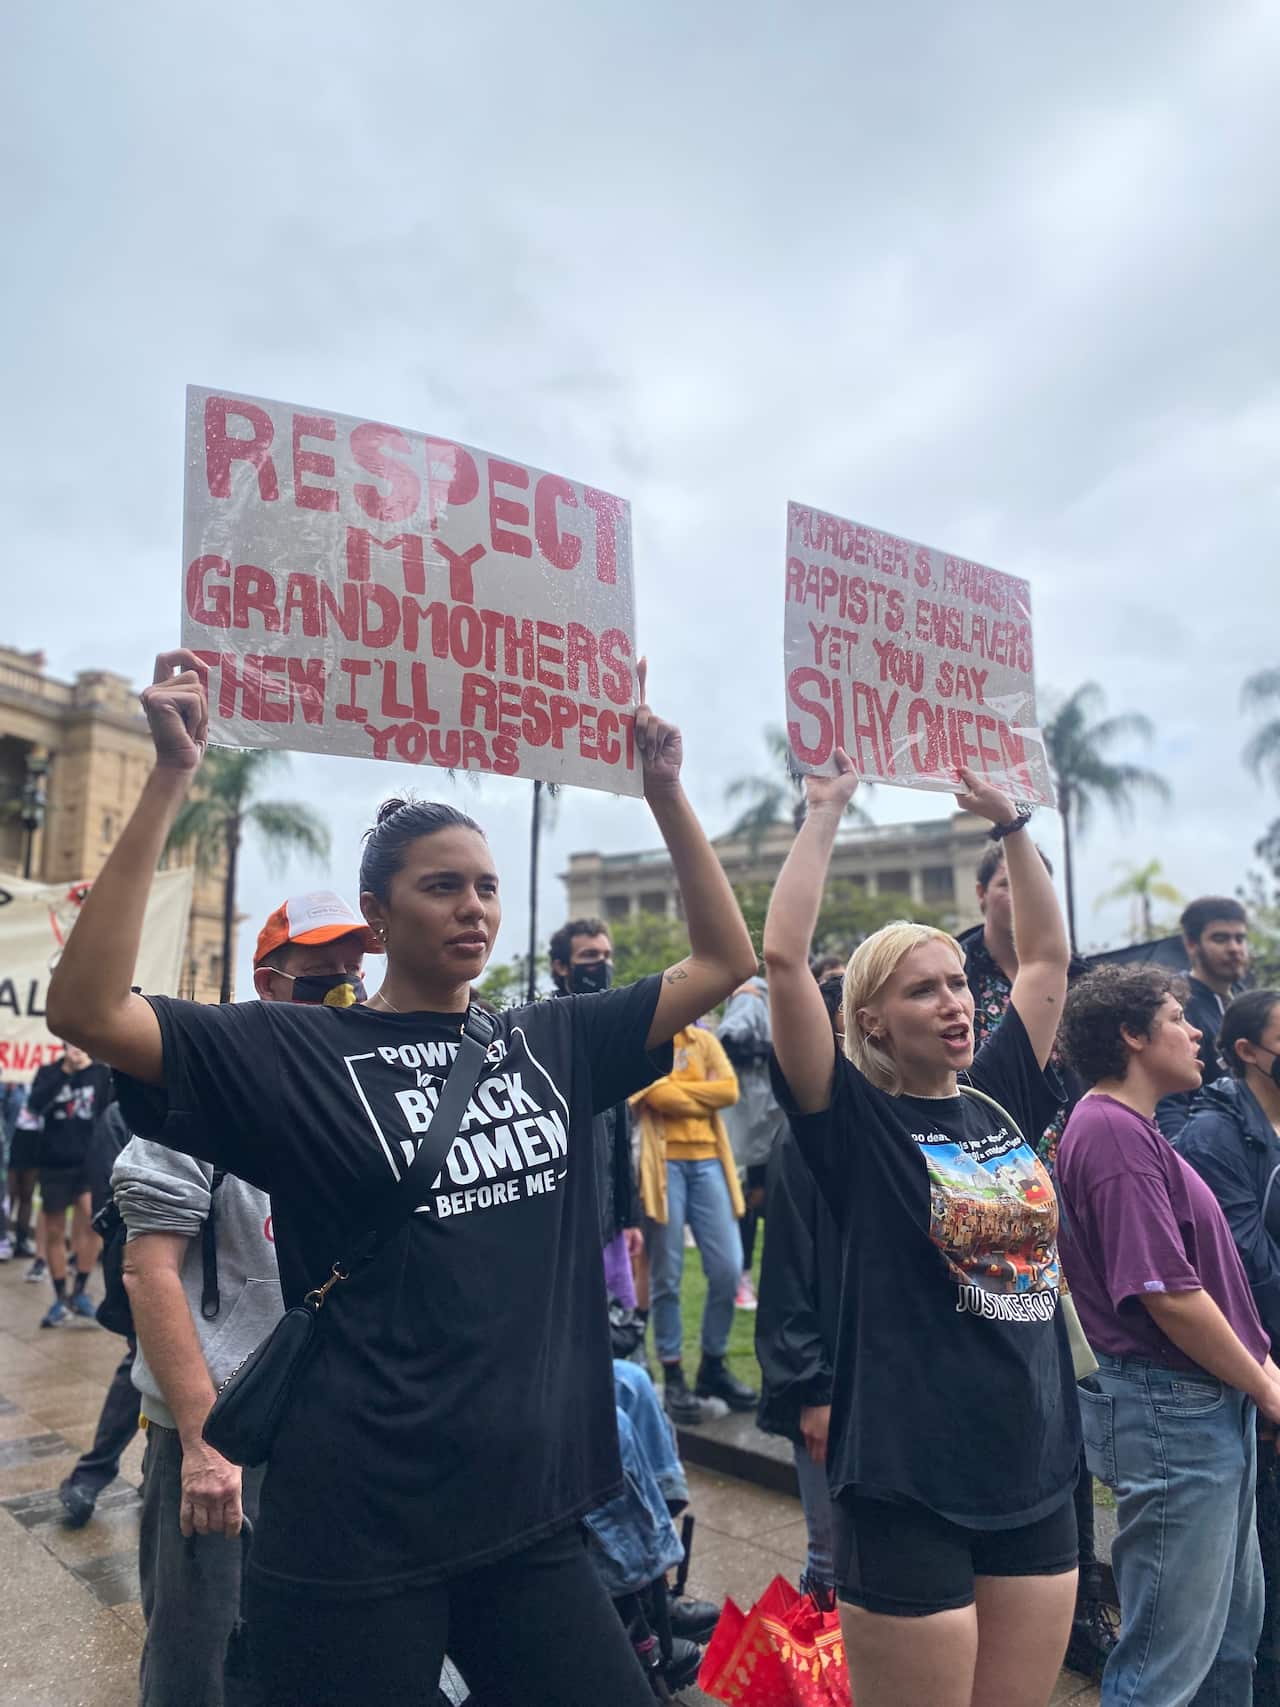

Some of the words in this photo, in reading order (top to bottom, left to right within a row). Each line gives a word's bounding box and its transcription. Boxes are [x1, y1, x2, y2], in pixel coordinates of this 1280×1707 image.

[204, 396, 628, 585] RESPECT
[346, 526, 486, 604] MY
[785, 557, 911, 640] RAPISTS,
[916, 599, 1033, 673] ENSLAVERS
[186, 554, 632, 705] GRANDMOTHERS
[808, 621, 858, 675] YET
[872, 637, 924, 693] YOU
[935, 660, 989, 705] SAY
[190, 649, 325, 725] THEN
[335, 658, 440, 724] I'LL
[460, 673, 634, 770] RESPECT
[364, 723, 520, 776] YOURS
[787, 666, 899, 777] SLAY
[436, 1179, 520, 1218] BEFORE
[525, 1169, 557, 1197] ME
